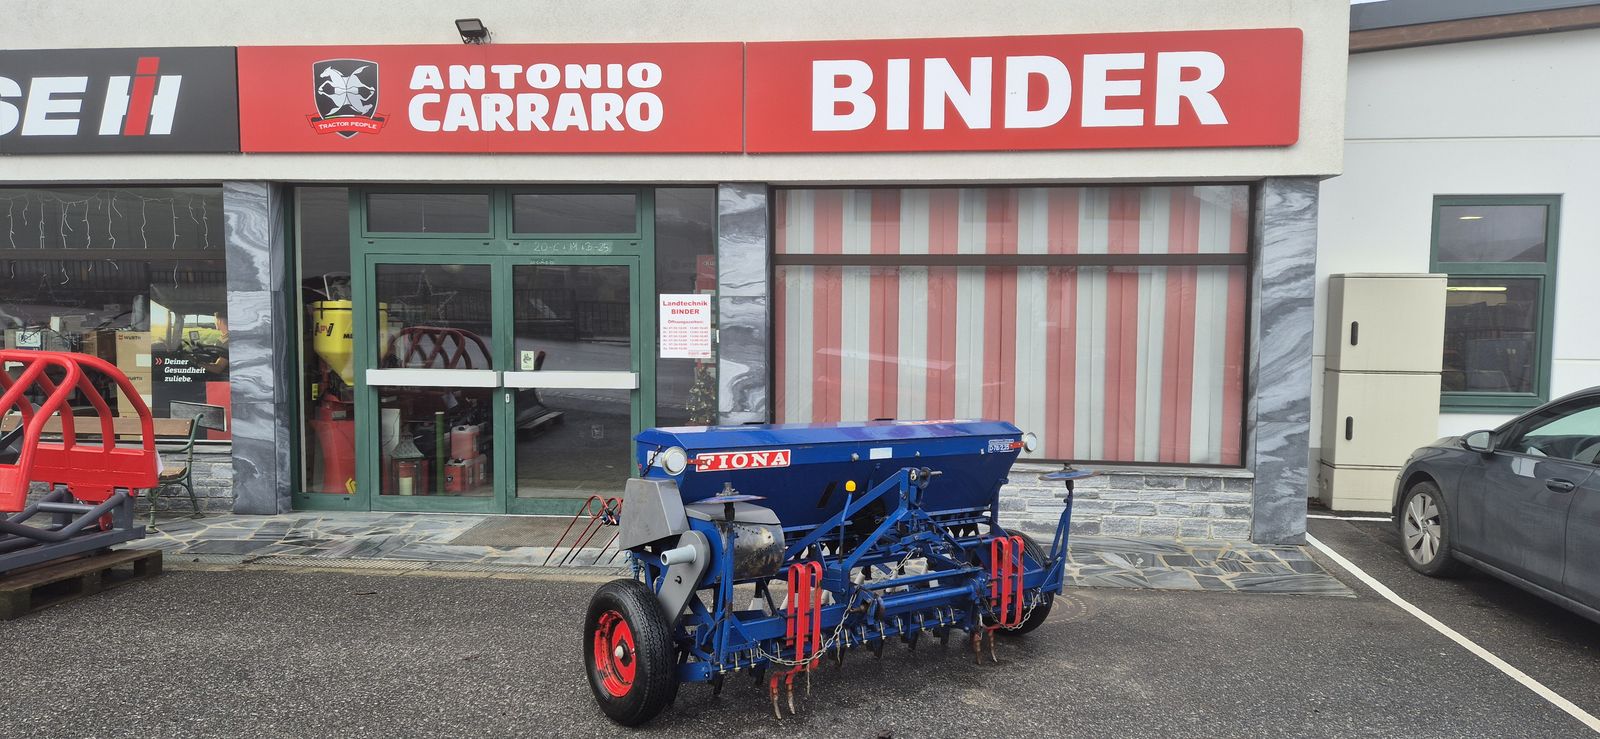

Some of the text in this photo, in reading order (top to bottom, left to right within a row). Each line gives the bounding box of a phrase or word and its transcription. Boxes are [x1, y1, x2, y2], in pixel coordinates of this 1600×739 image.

[408, 62, 663, 90] ANTONIO
[811, 50, 1229, 132] BINDER
[407, 91, 665, 133] CARRARO
[318, 121, 377, 130] TRACTOR PEOPLE
[164, 366, 206, 375] Gesundheit
[698, 452, 788, 470] FIONA
